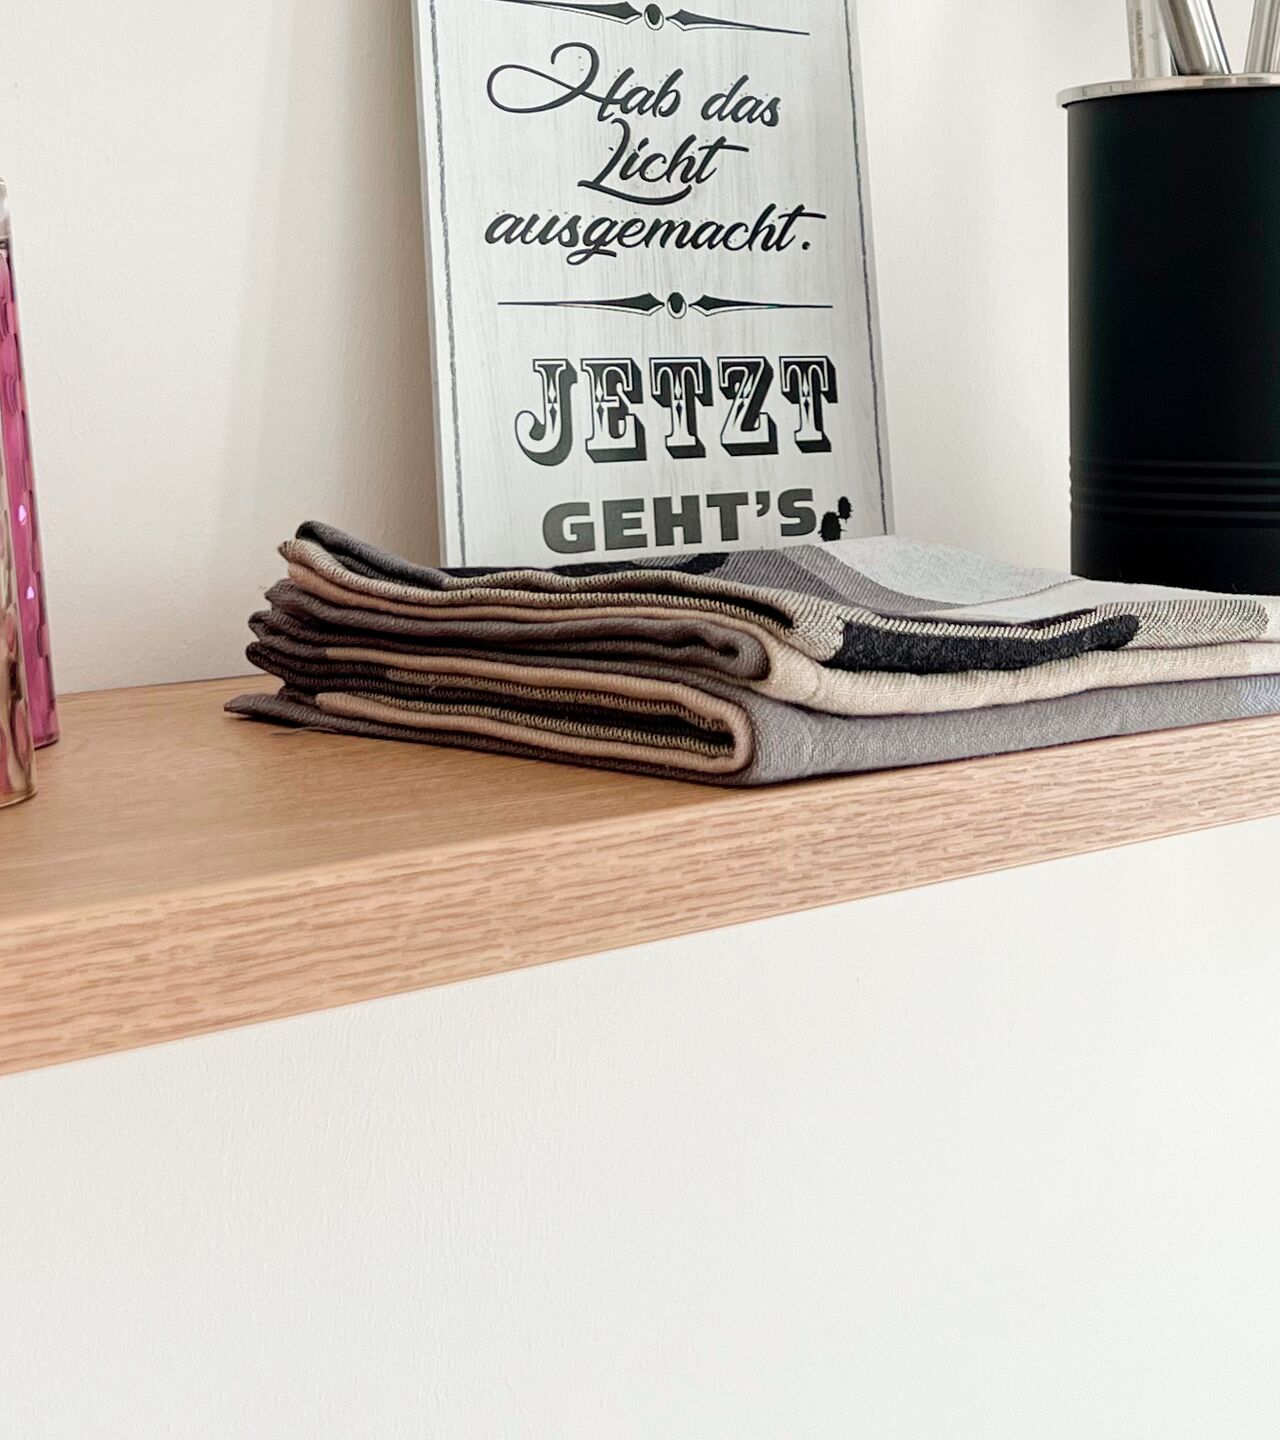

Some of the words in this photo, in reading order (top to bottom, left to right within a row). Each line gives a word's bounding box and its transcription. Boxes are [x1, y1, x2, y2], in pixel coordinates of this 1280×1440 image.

[486, 42, 684, 124] Hab
[700, 74, 781, 128] das
[578, 117, 750, 206] Licht
[484, 201, 827, 266] ausgemacht.
[514, 355, 839, 467] JETZT
